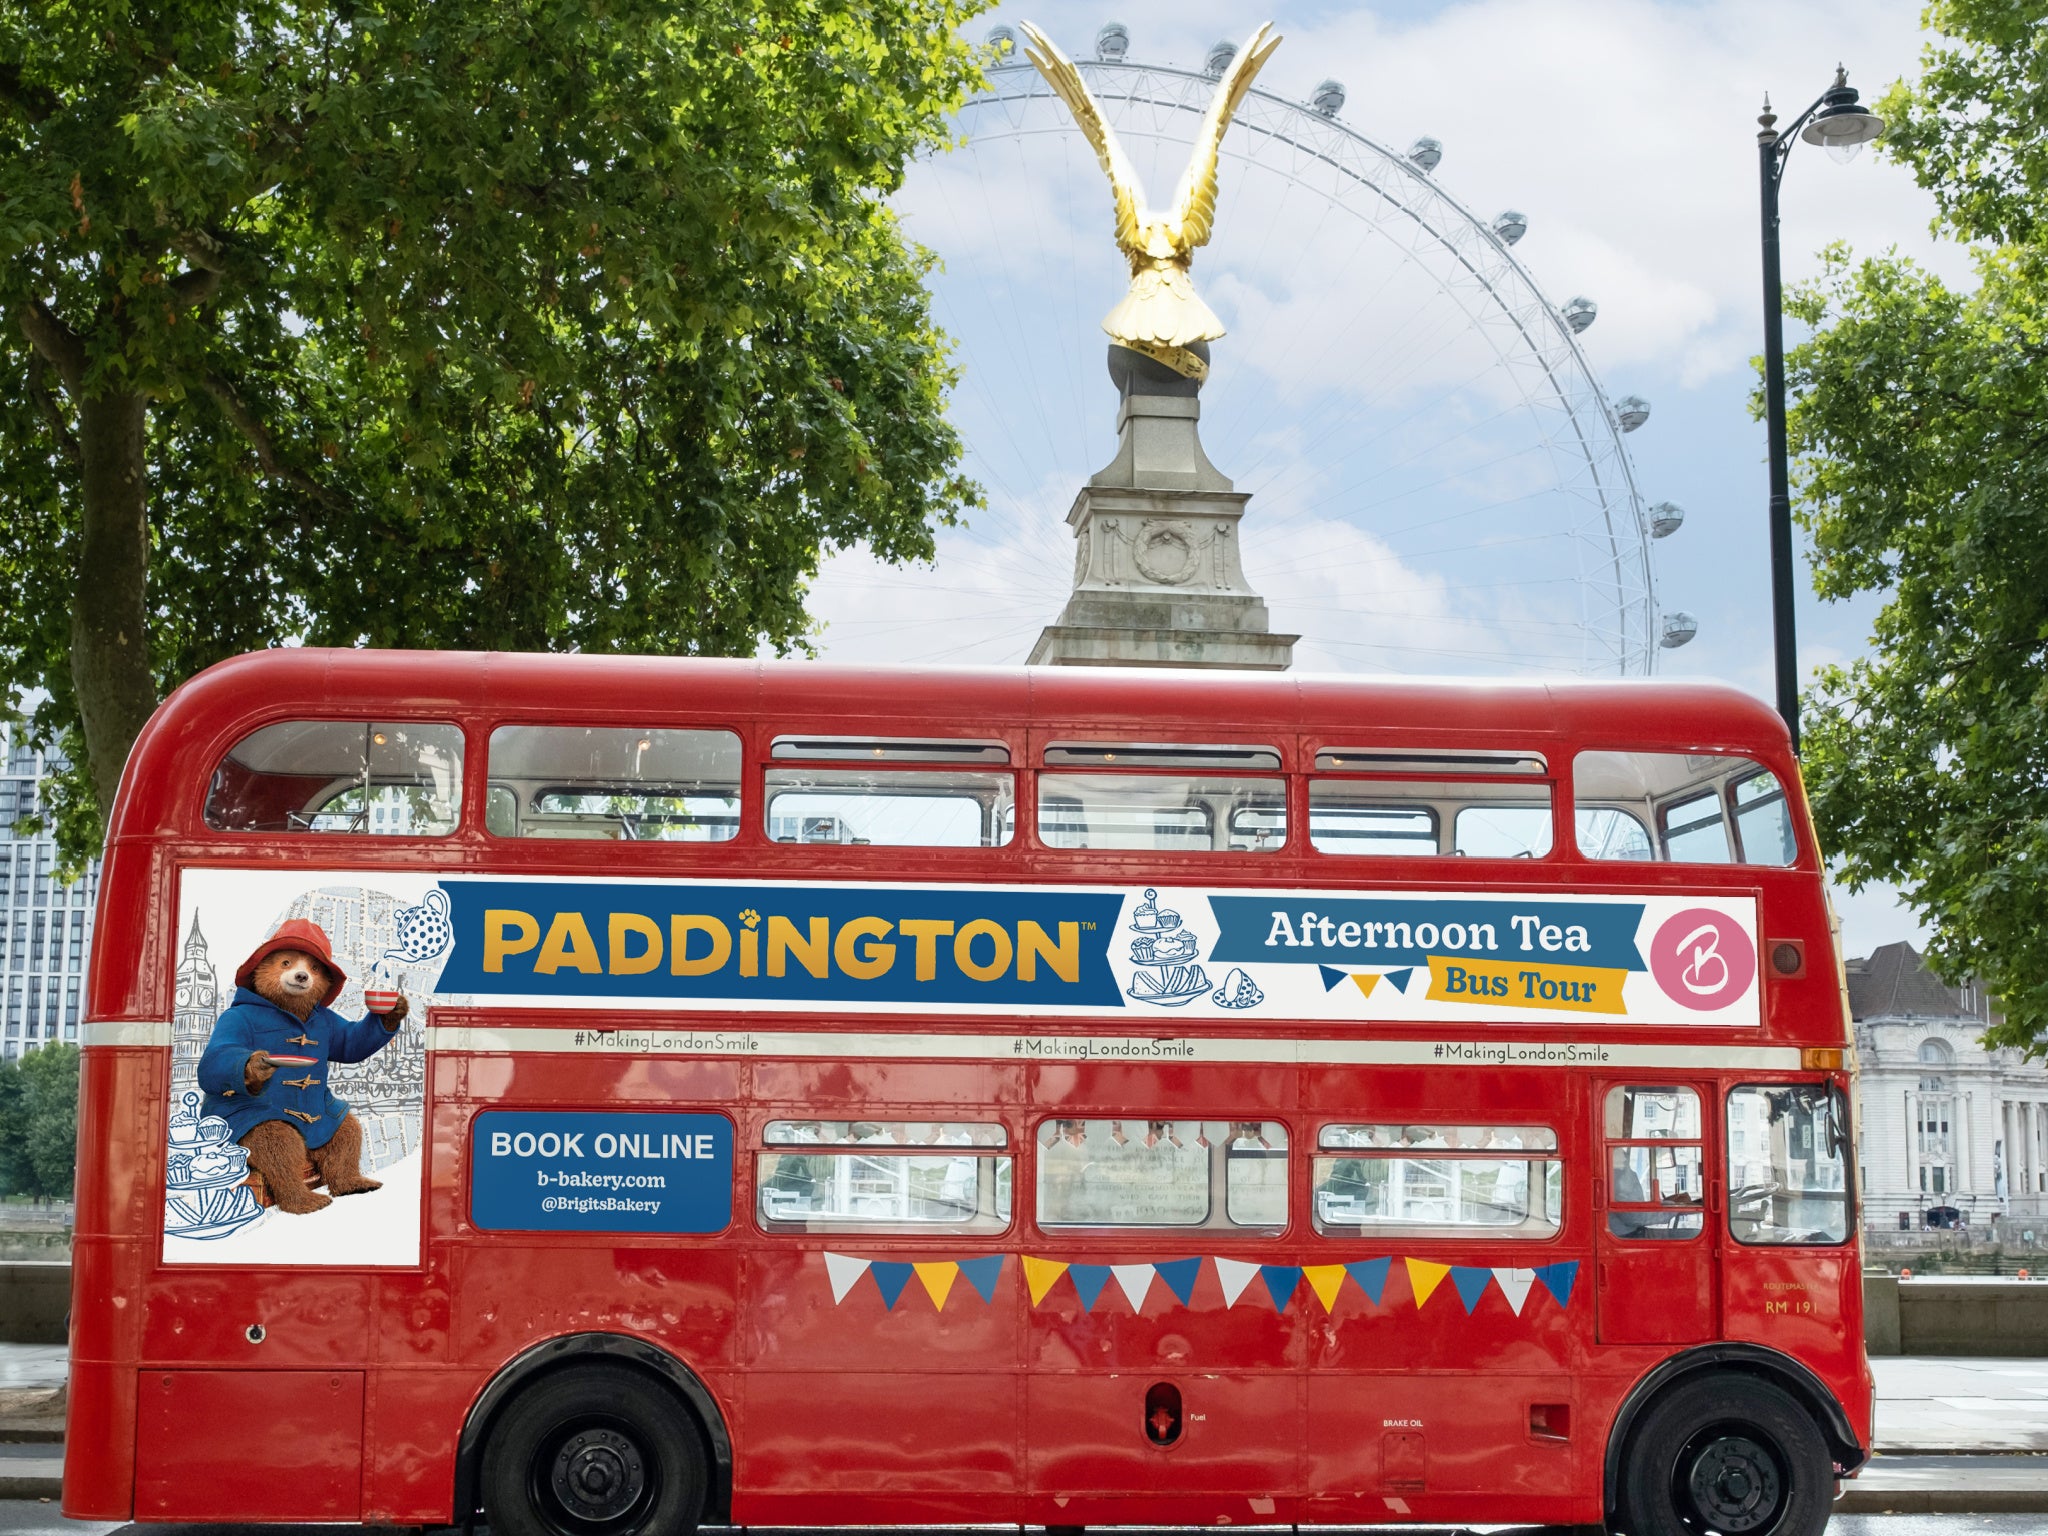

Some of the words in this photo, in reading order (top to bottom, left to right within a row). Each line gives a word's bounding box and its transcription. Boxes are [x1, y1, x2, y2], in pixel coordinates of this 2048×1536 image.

[1264, 911, 1499, 950] Afternoon
[1510, 915, 1592, 952] Tea
[483, 908, 1080, 983] PADDINGTON
[1675, 924, 1730, 995] B
[1444, 966, 1509, 997] Bus
[1518, 972, 1597, 1003] Tour
[574, 1033, 759, 1053] #MakingLondonSmile
[1014, 1038, 1195, 1060] #MakingLondonSmile
[1433, 1043, 1609, 1064] #MakingLondonSmile
[491, 1132, 585, 1158] BOOK
[594, 1133, 714, 1159] ONLINE
[537, 1170, 666, 1191] b-bakery.com
[541, 1197, 661, 1215] @BrigitsBakery
[1765, 1301, 1787, 1314] RM
[1796, 1301, 1818, 1314] 191
[1190, 1413, 1206, 1421] Fuel
[1383, 1419, 1409, 1427] BRAKE
[1410, 1419, 1424, 1427] OIL
